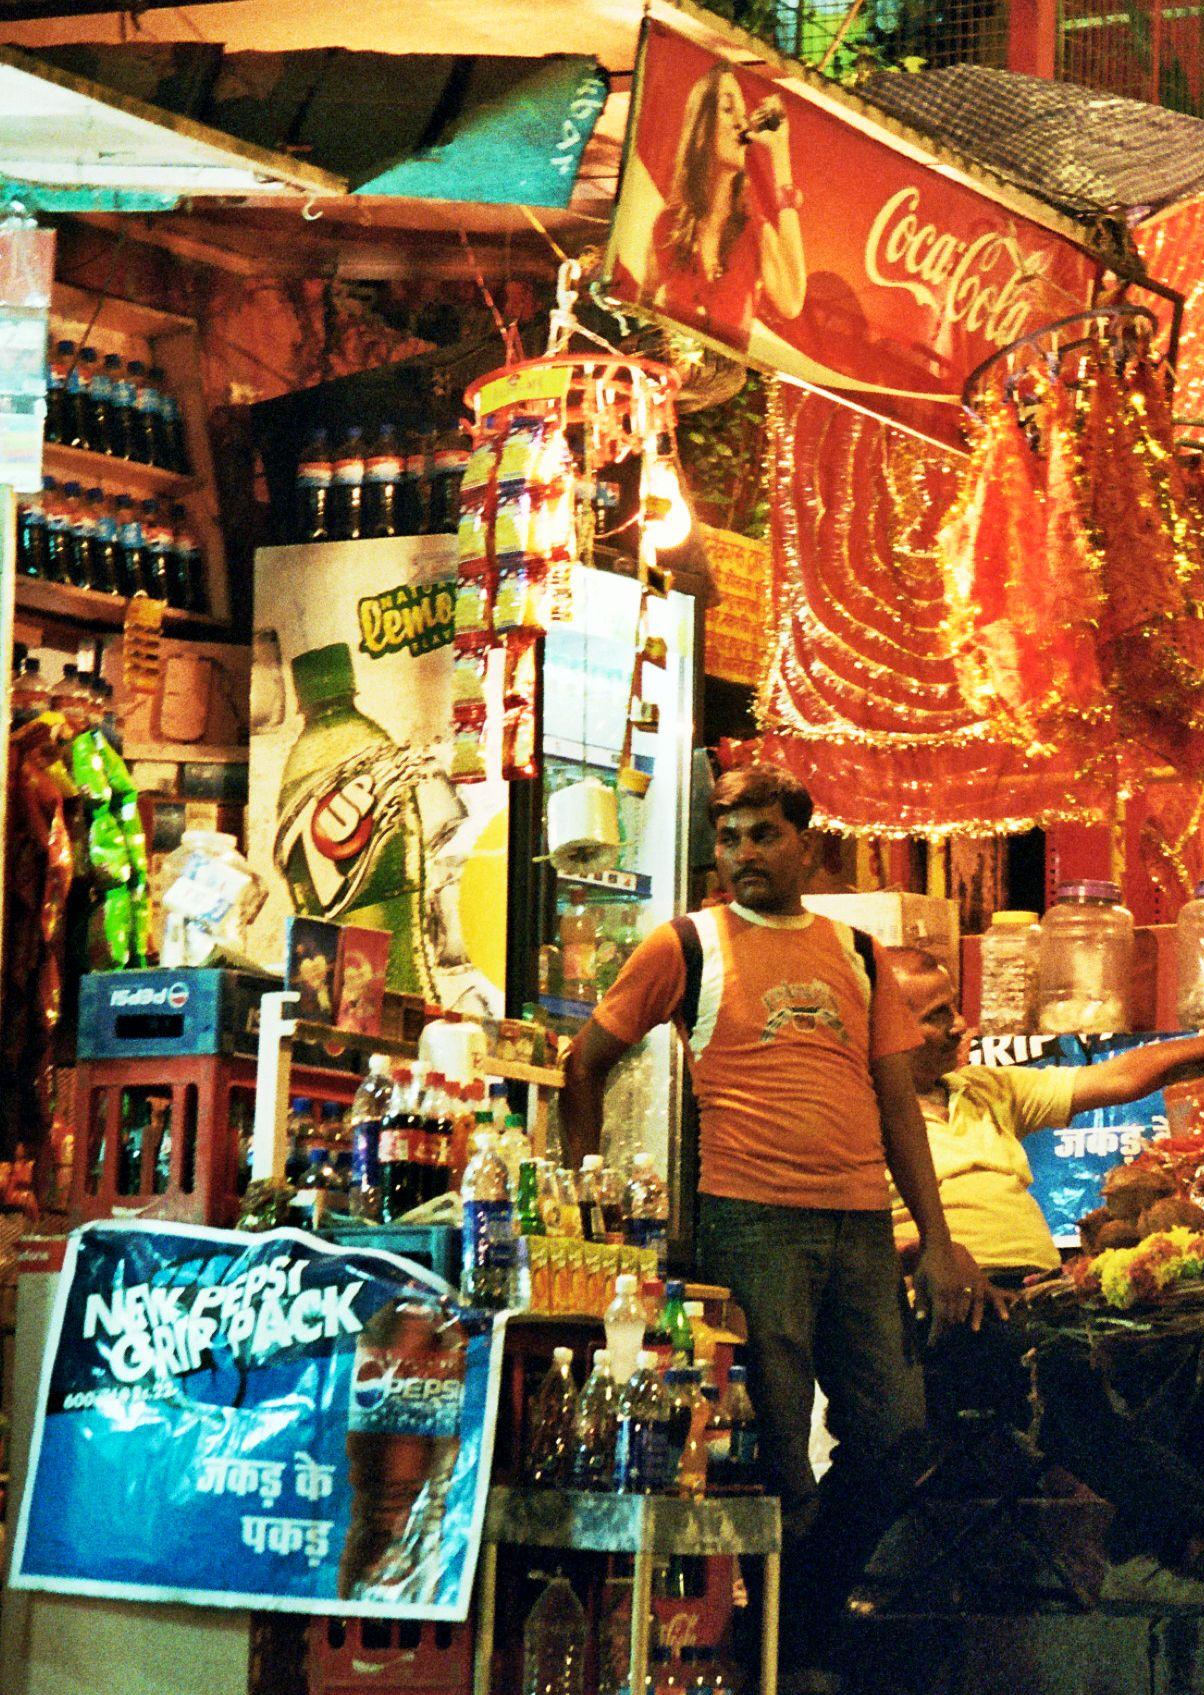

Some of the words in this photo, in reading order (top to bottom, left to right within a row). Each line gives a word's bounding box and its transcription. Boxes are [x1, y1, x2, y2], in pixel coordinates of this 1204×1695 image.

[865, 186, 1042, 349] Coca-Cola
[84, 1283, 186, 1338] NEW
[109, 1316, 217, 1383] GRIP
[227, 1281, 364, 1358] PACK
[294, 1451, 337, 1501] के
[240, 1515, 335, 1567] पकड़
